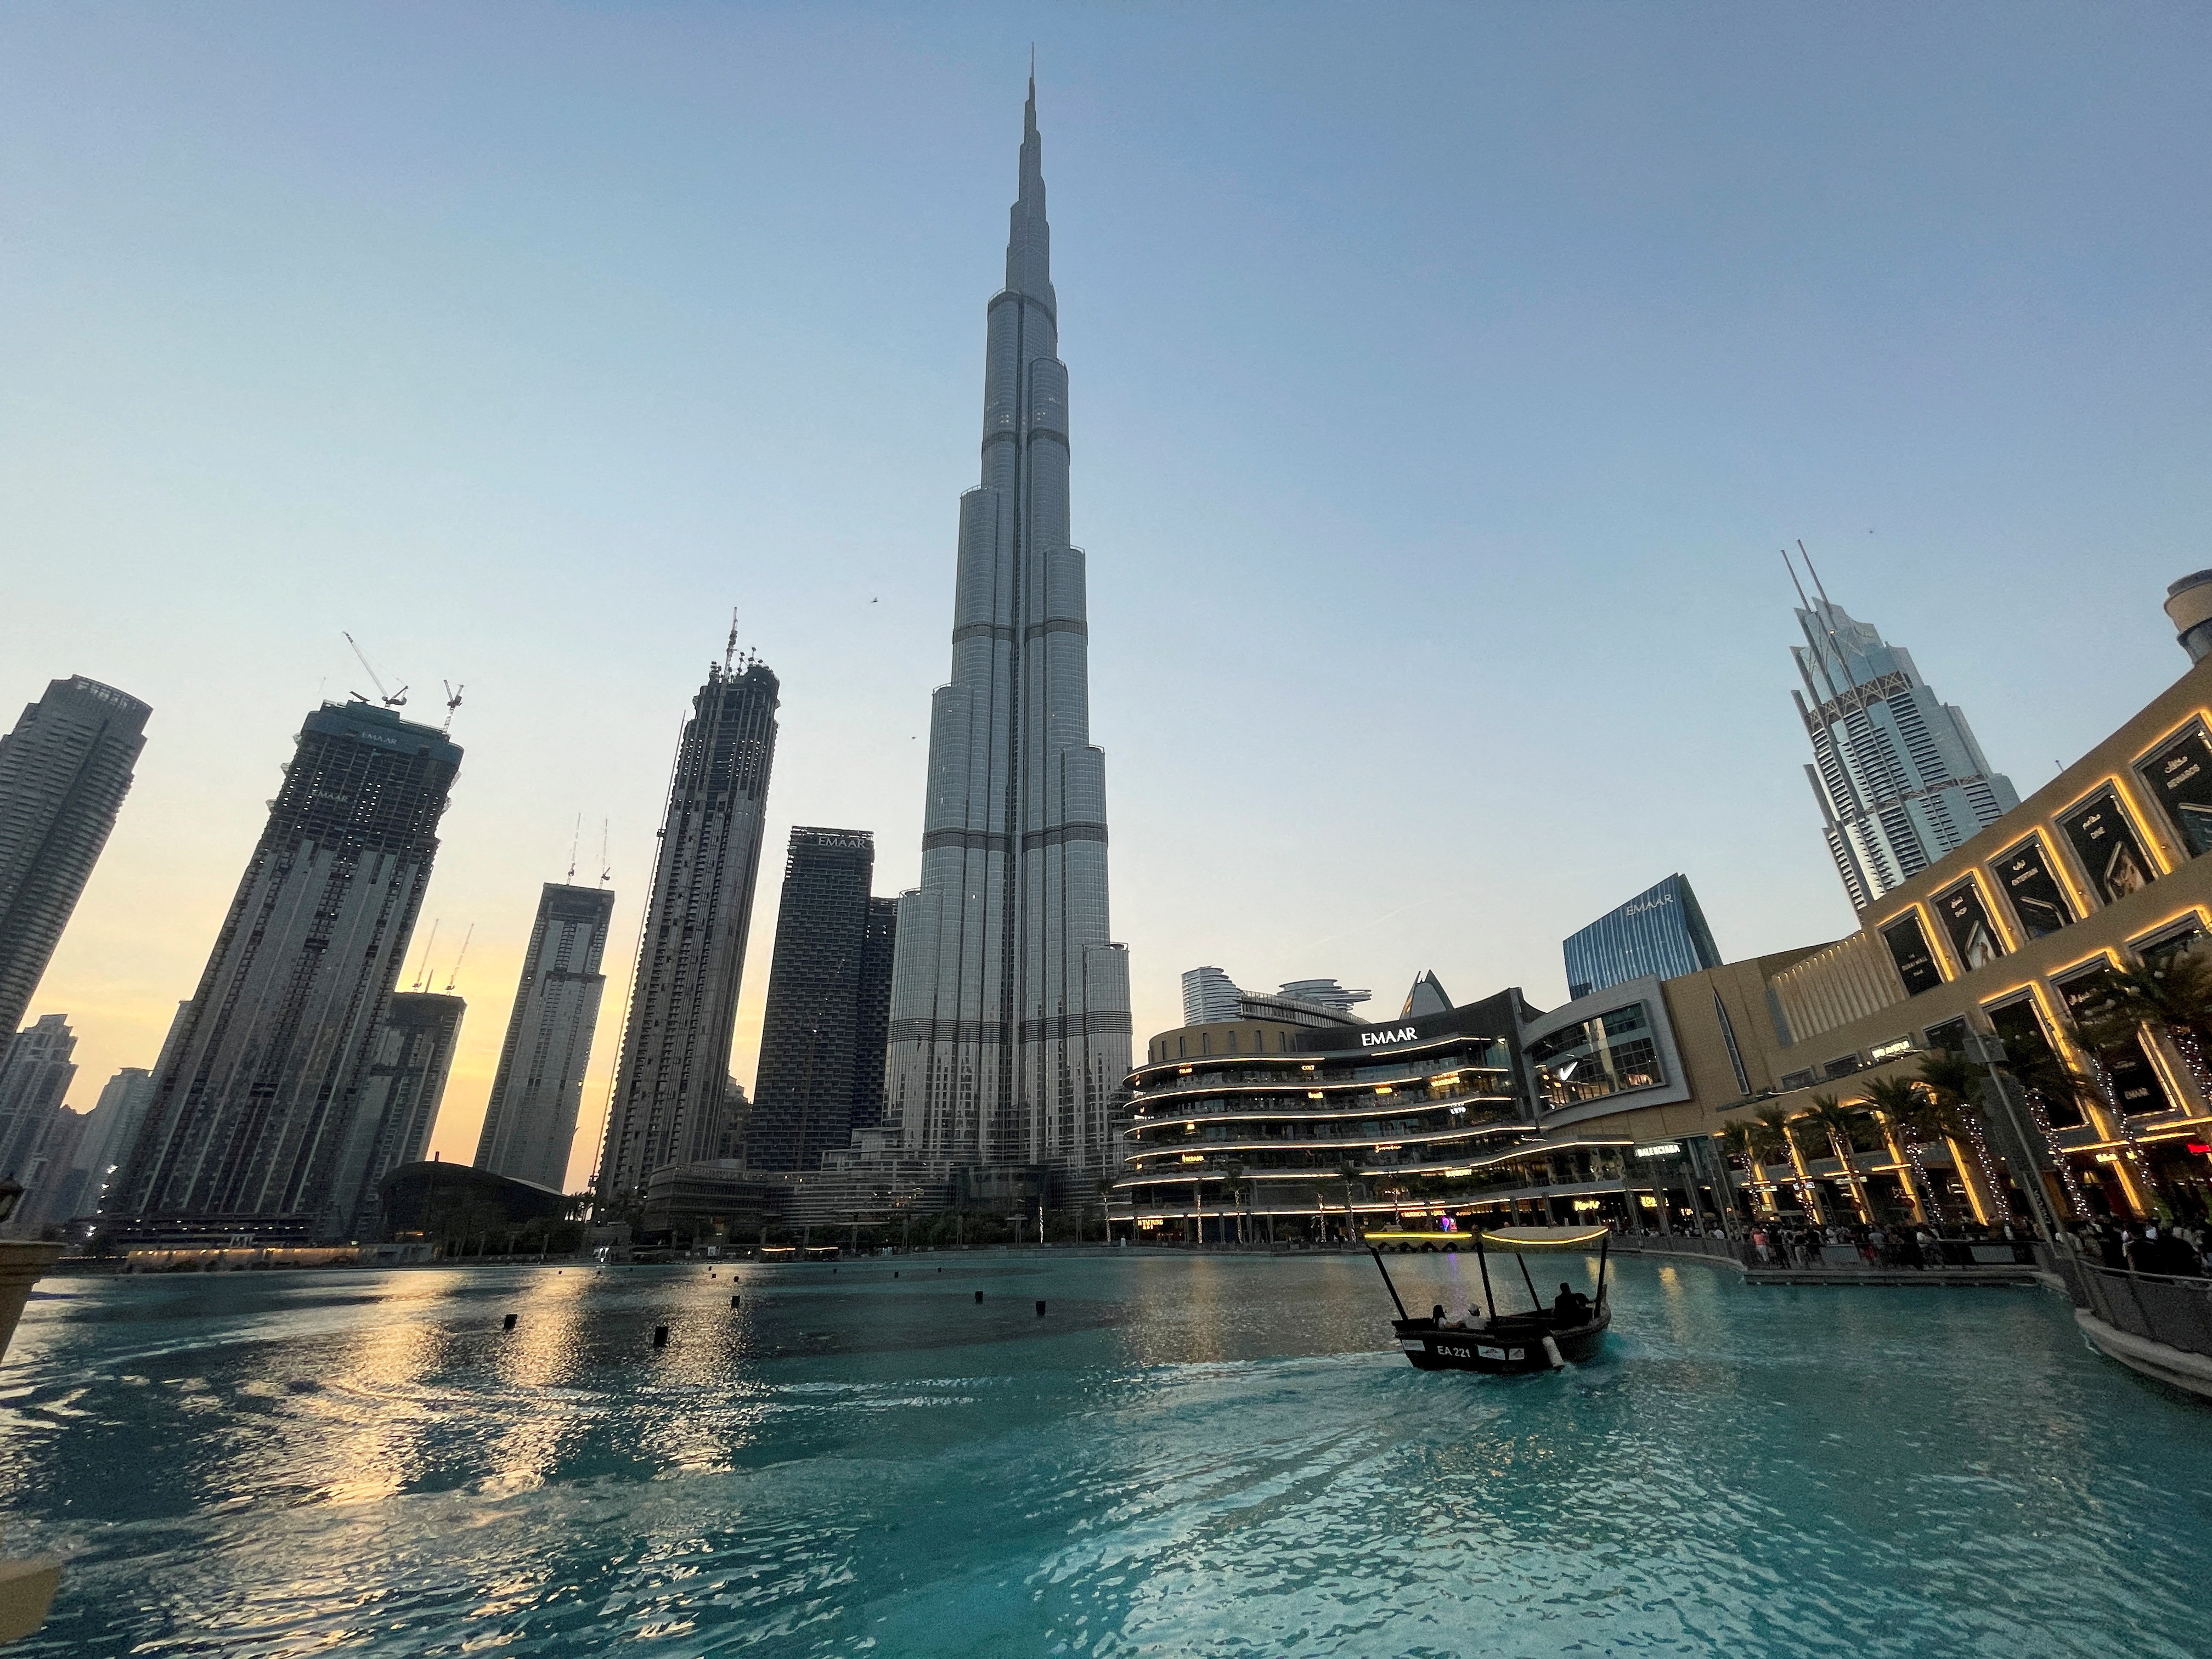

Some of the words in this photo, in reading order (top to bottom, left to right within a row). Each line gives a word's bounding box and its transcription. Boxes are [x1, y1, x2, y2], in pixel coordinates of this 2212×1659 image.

[362, 732, 397, 744] EMAAR
[312, 791, 348, 803] EMAAR
[818, 836, 867, 849] EMAAR
[1626, 894, 1673, 916] EMAAR
[1361, 1027, 1418, 1046] EMAAR
[1637, 1144, 1680, 1157] BALENCIAGA
[1437, 1345, 1453, 1356] EA
[1453, 1347, 1471, 1358] 221
